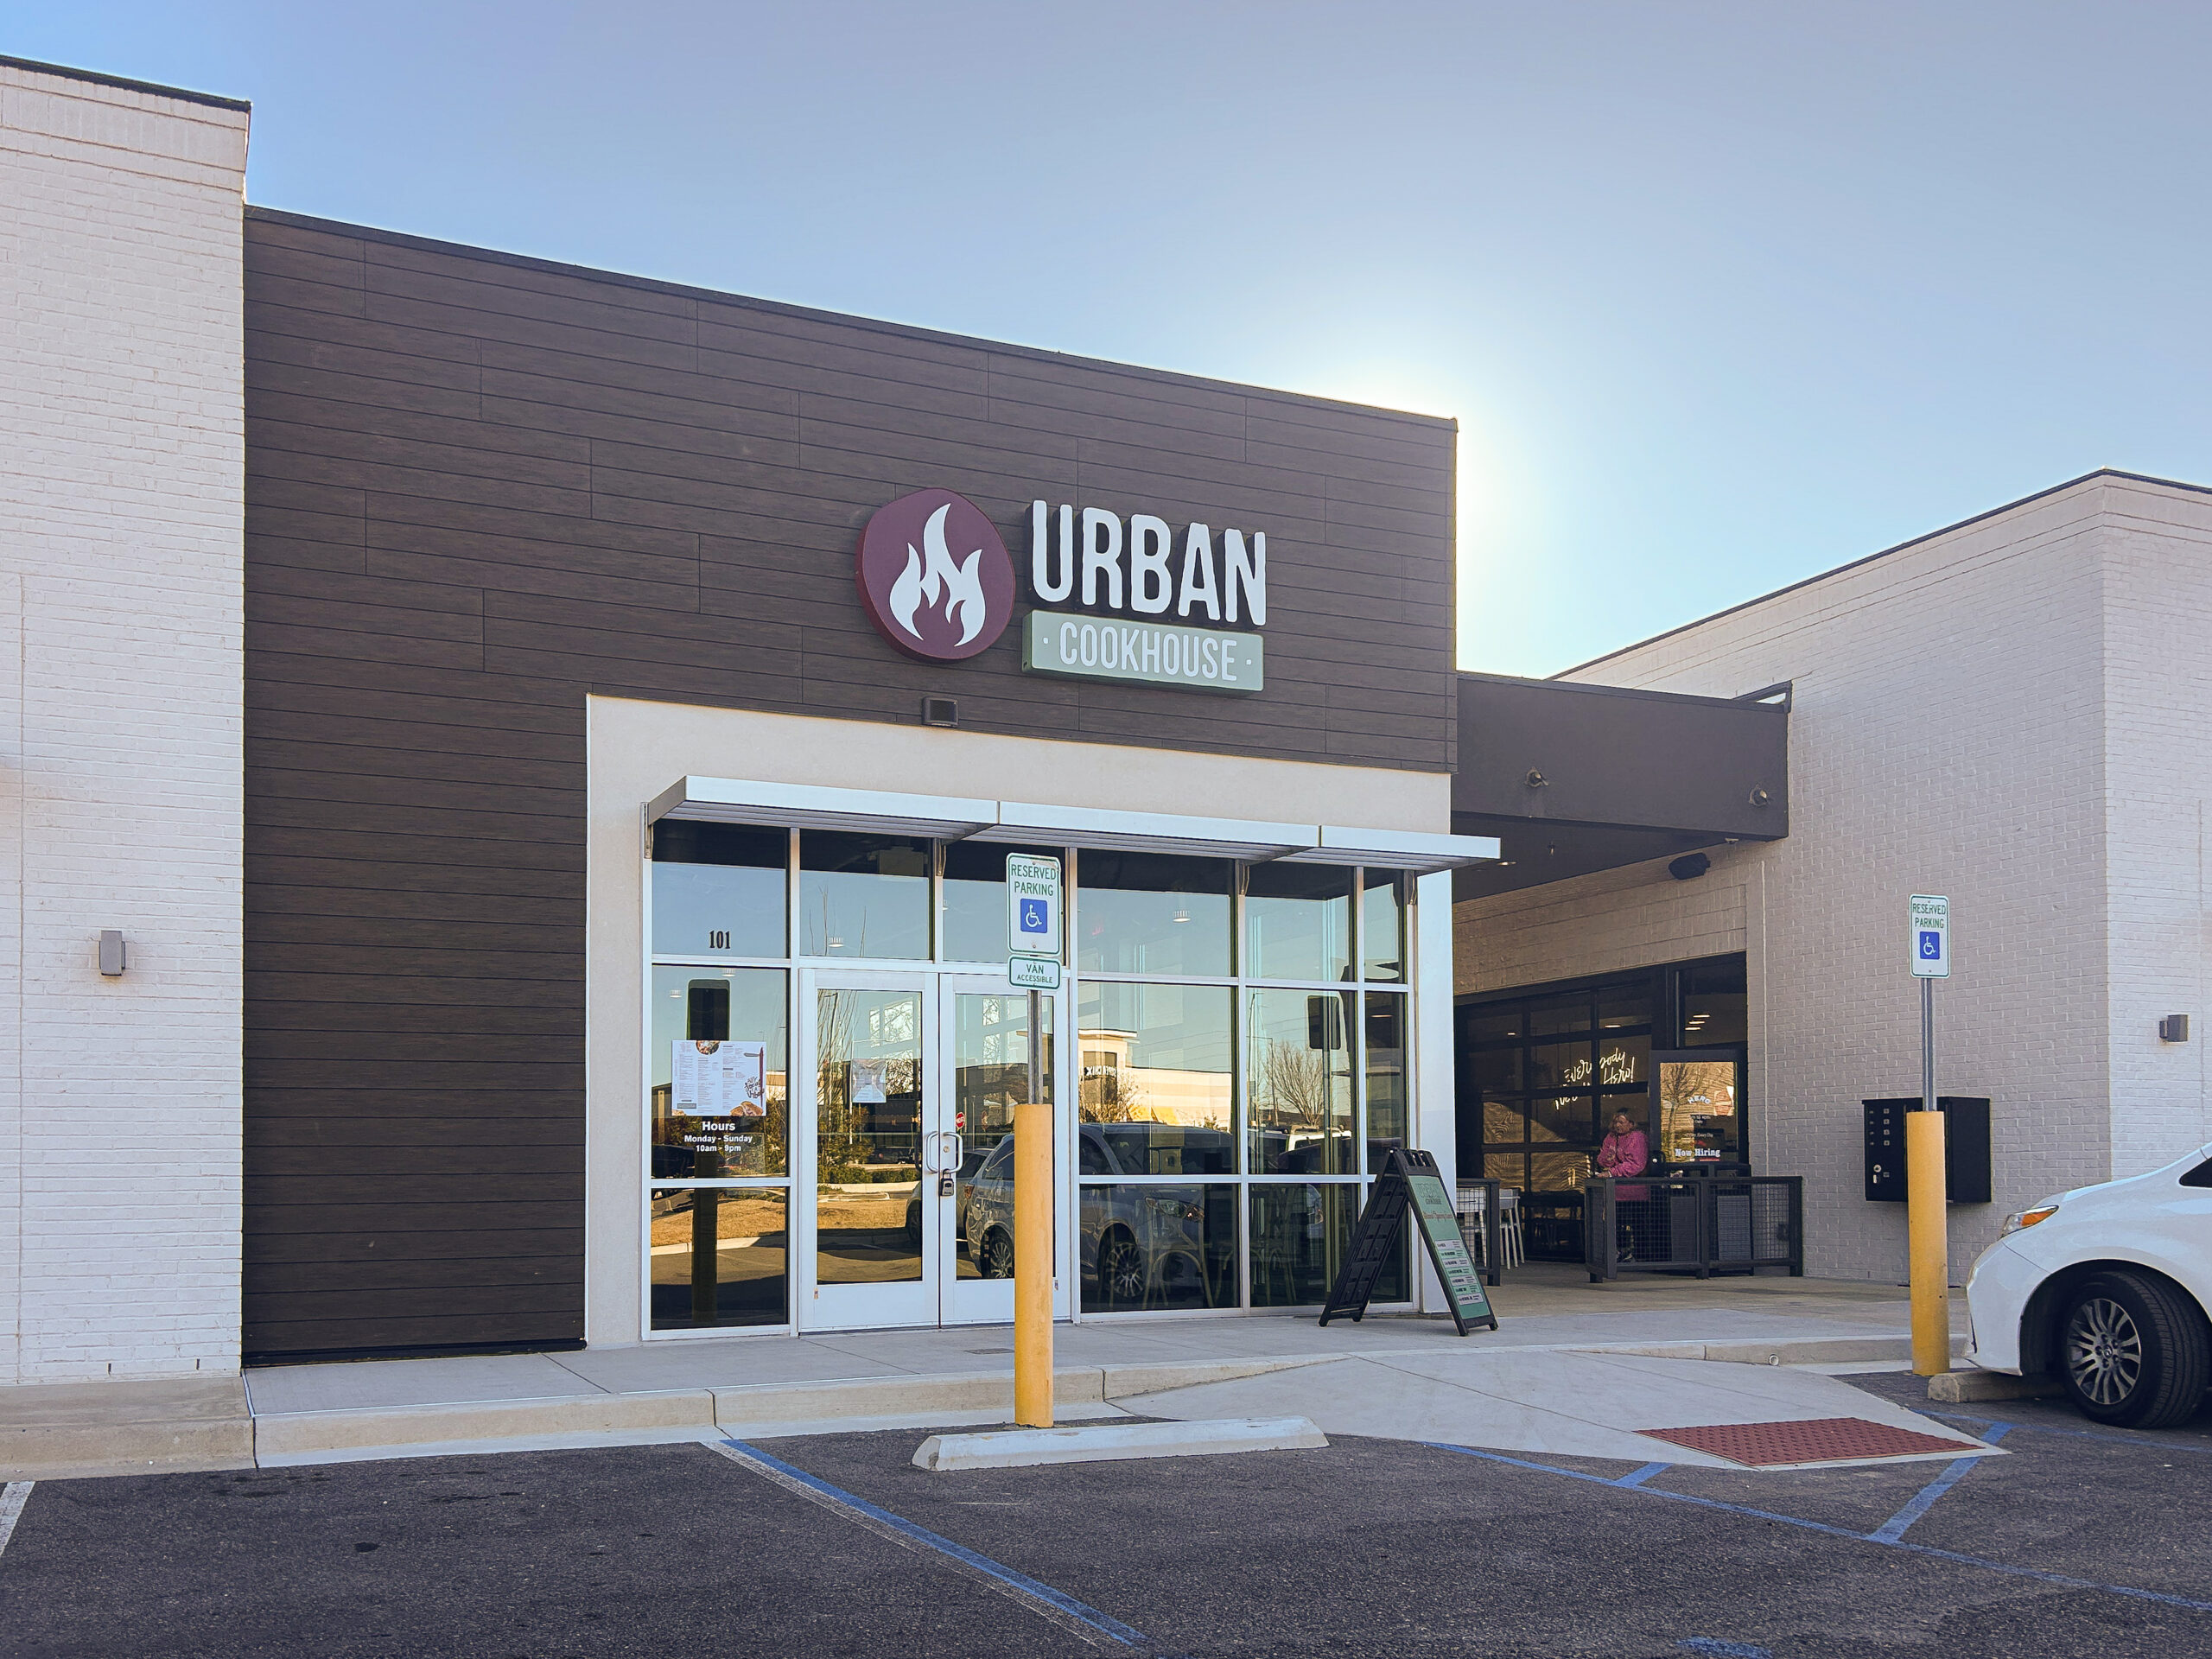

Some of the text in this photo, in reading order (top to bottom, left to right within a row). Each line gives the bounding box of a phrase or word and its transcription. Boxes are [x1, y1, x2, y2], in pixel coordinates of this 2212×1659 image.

[1032, 499, 1267, 626] URBAN
[1059, 621, 1237, 682] COOKHOUSE
[1011, 864, 1056, 880] RESERVED
[1014, 881, 1053, 896] PARKING
[1912, 903, 1946, 914] RESERVED
[1915, 918, 1944, 928] PARKING
[709, 930, 731, 950] 101
[1026, 964, 1044, 975] VAN
[1017, 975, 1053, 983] ACCESSIBLE
[1687, 1095, 1712, 1104] HERO
[702, 1122, 735, 1130] Hours
[1675, 1148, 1720, 1157] Now Hiring
